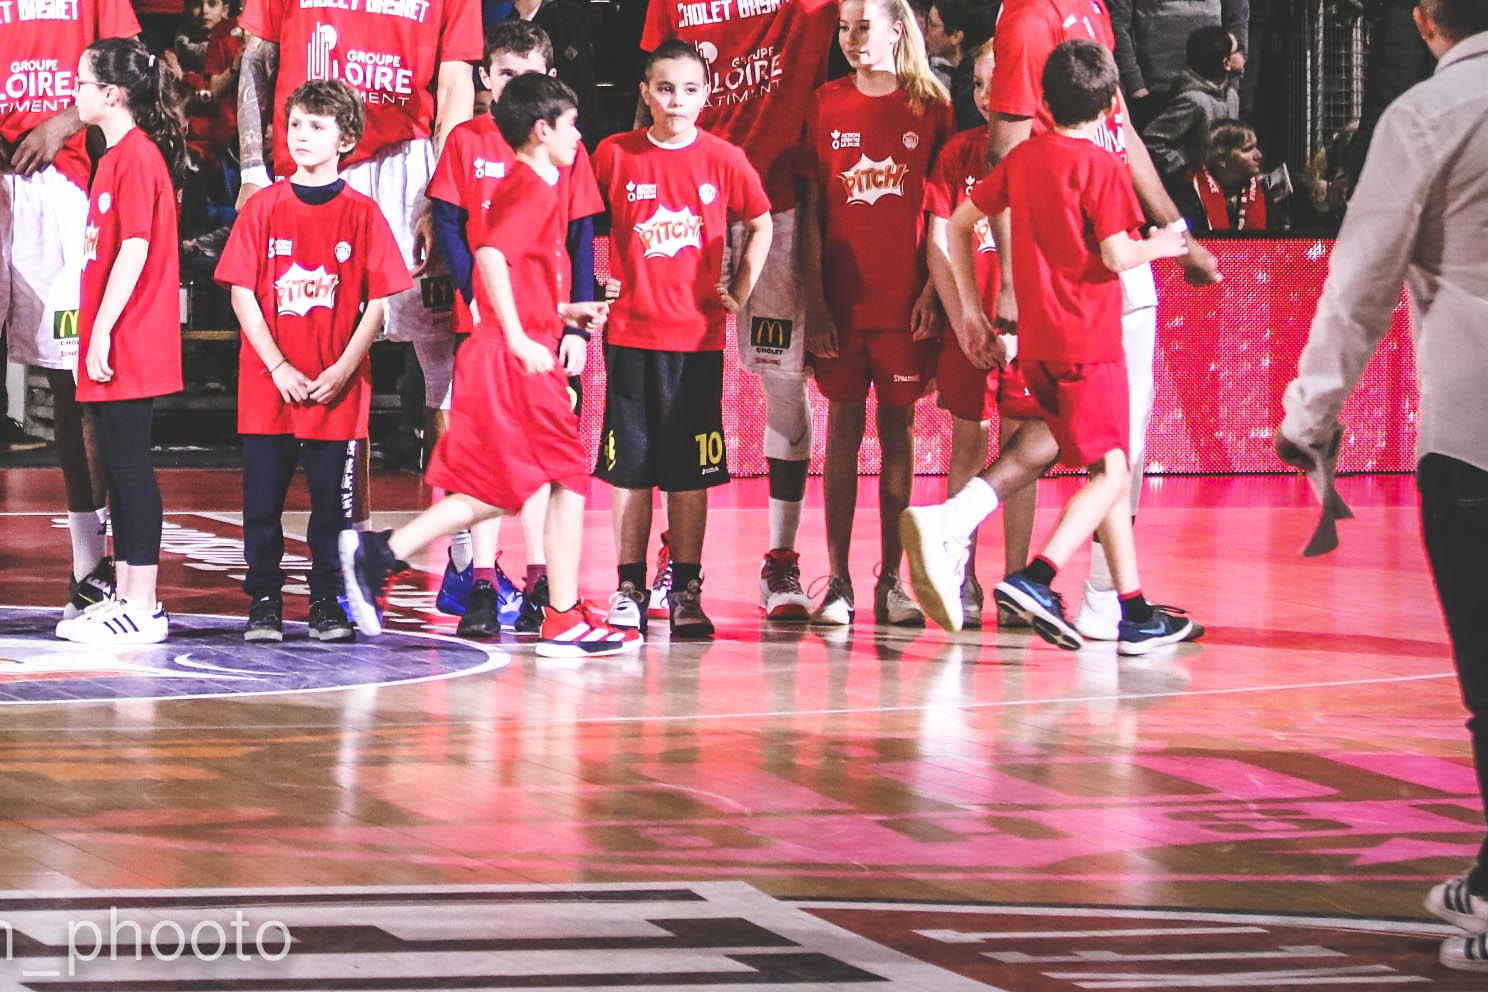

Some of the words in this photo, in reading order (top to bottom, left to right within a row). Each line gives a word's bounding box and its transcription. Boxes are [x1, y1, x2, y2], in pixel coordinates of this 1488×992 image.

[10, 59, 59, 73] GROUPE
[346, 49, 401, 67] GROUPE
[842, 163, 907, 199] PITCH
[638, 215, 704, 250] PITCH
[275, 273, 339, 308] PITCH
[695, 431, 723, 466] 10
